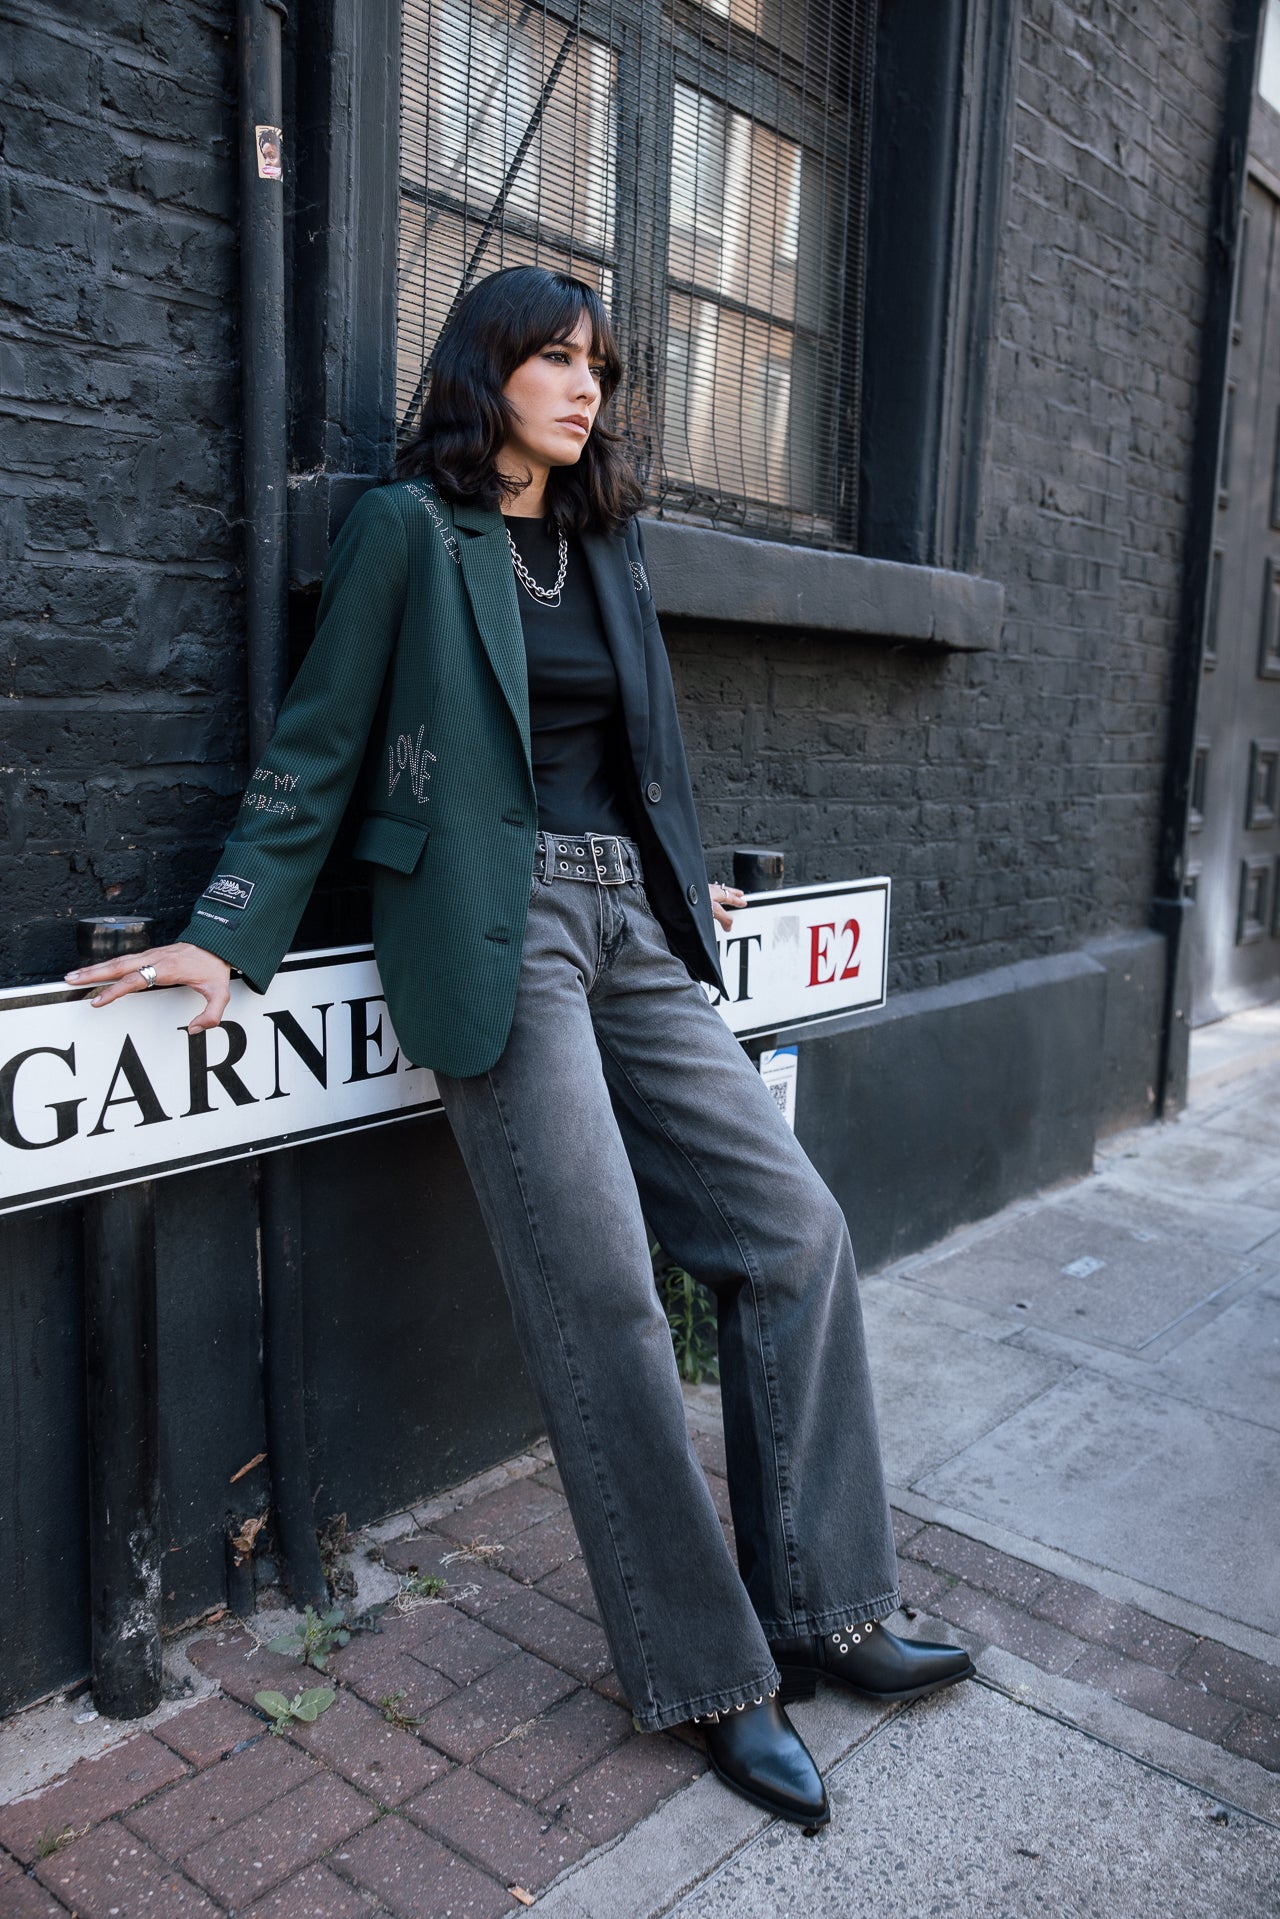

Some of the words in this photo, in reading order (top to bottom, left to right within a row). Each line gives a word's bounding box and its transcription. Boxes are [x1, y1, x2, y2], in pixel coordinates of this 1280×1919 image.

[274, 773, 301, 792] MY
[388, 723, 437, 804] LOVE
[0, 994, 423, 1151] GARNE
[805, 918, 861, 988] E2
